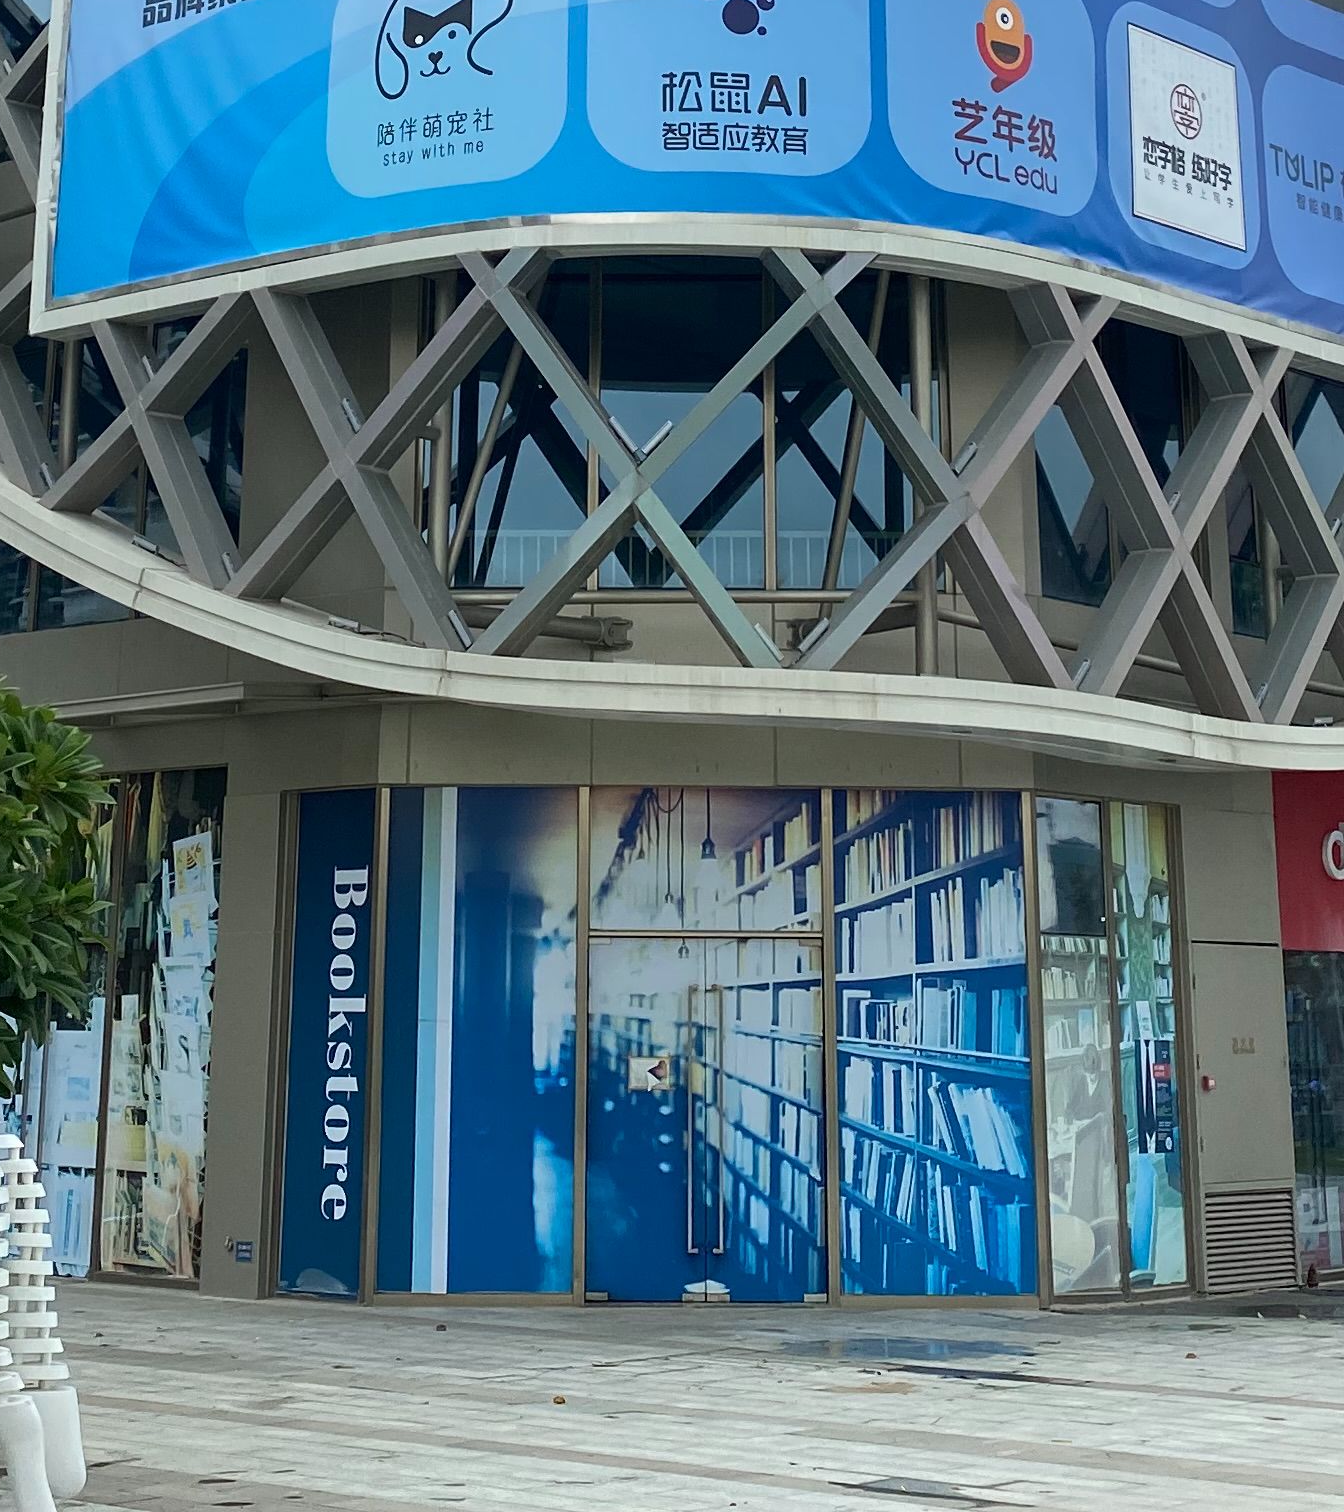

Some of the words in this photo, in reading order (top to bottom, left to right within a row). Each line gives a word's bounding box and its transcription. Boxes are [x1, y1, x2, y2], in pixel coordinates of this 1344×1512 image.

[661, 71, 807, 117] 松鼠AI
[376, 106, 495, 148] 陪伴萌宠社
[661, 121, 809, 156] 智适应教育
[951, 97, 1058, 163] 艺年级
[382, 150, 414, 167] stay
[421, 142, 455, 161] with
[463, 140, 484, 156] me
[954, 146, 1011, 184] YCL
[1014, 165, 1058, 195] edu
[1269, 142, 1335, 193] TULIP
[320, 863, 370, 1222] Bookstore
